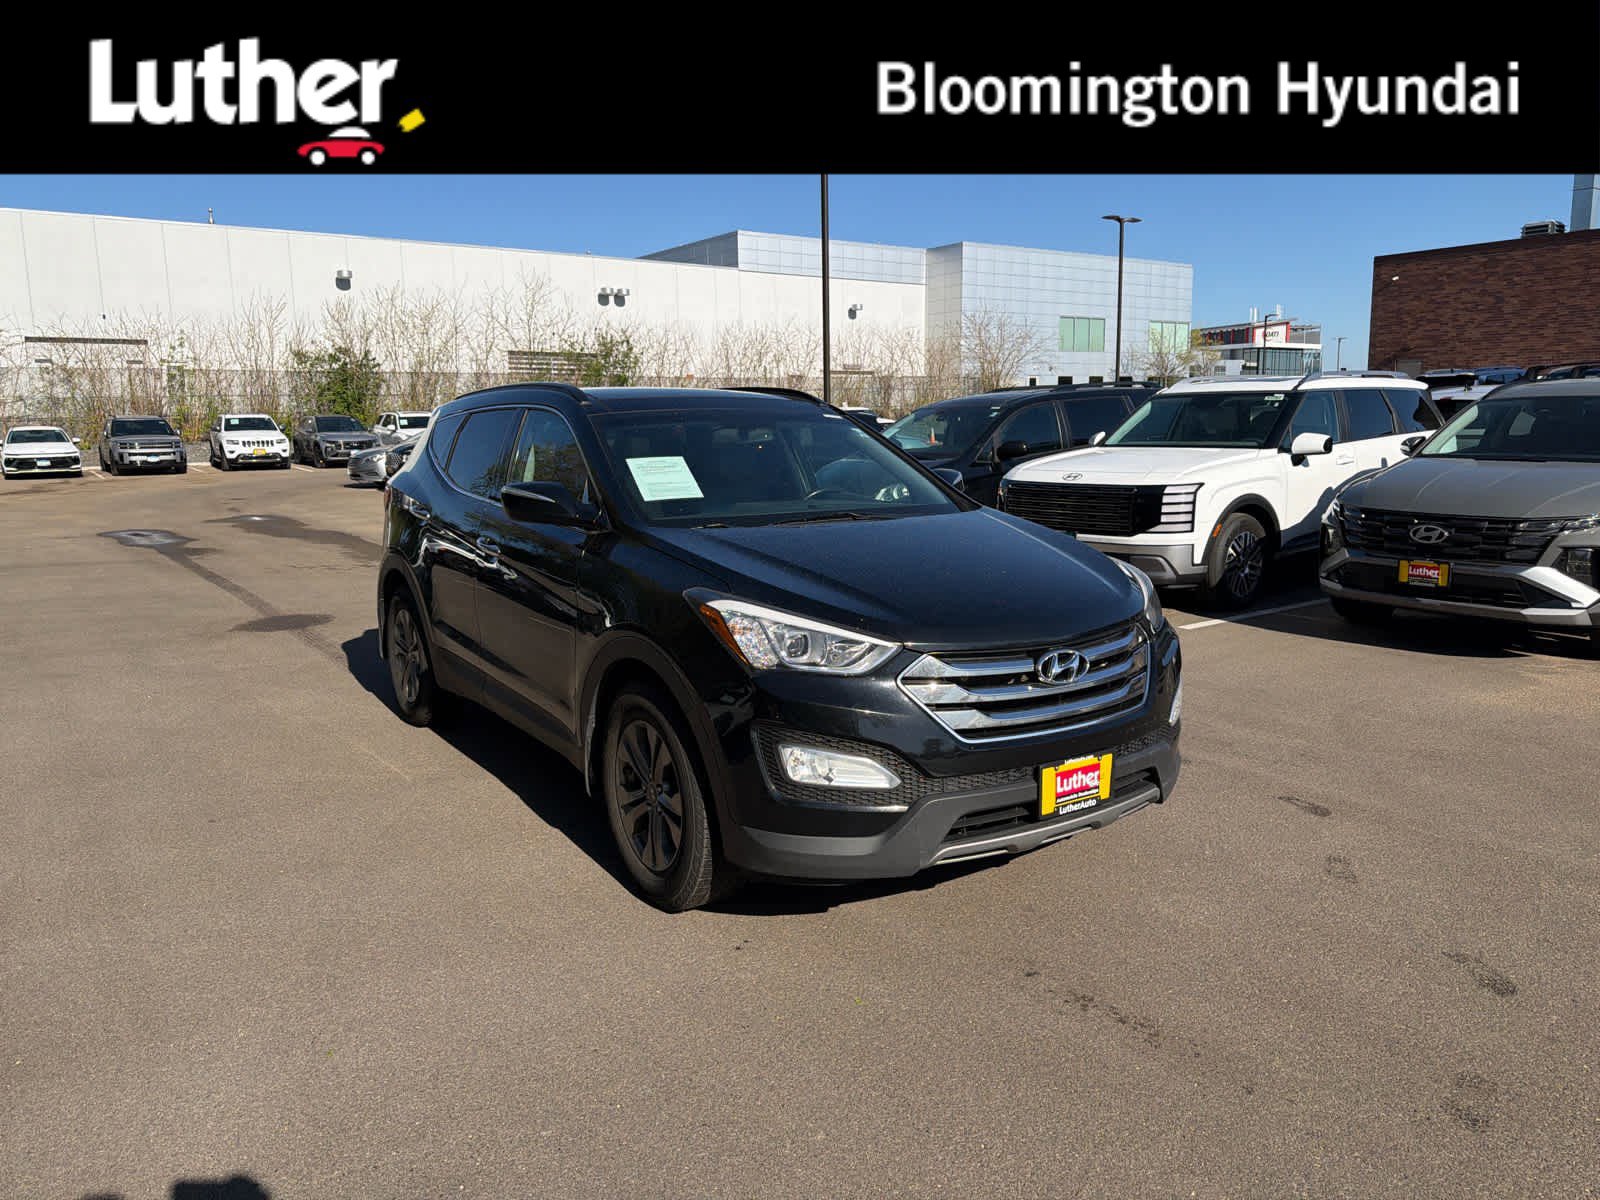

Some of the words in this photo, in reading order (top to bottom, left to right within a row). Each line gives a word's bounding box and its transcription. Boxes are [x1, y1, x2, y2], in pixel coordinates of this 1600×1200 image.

[1408, 565, 1439, 578] Luther
[1056, 769, 1100, 793] Luther
[1060, 798, 1097, 815] LutherAuto
